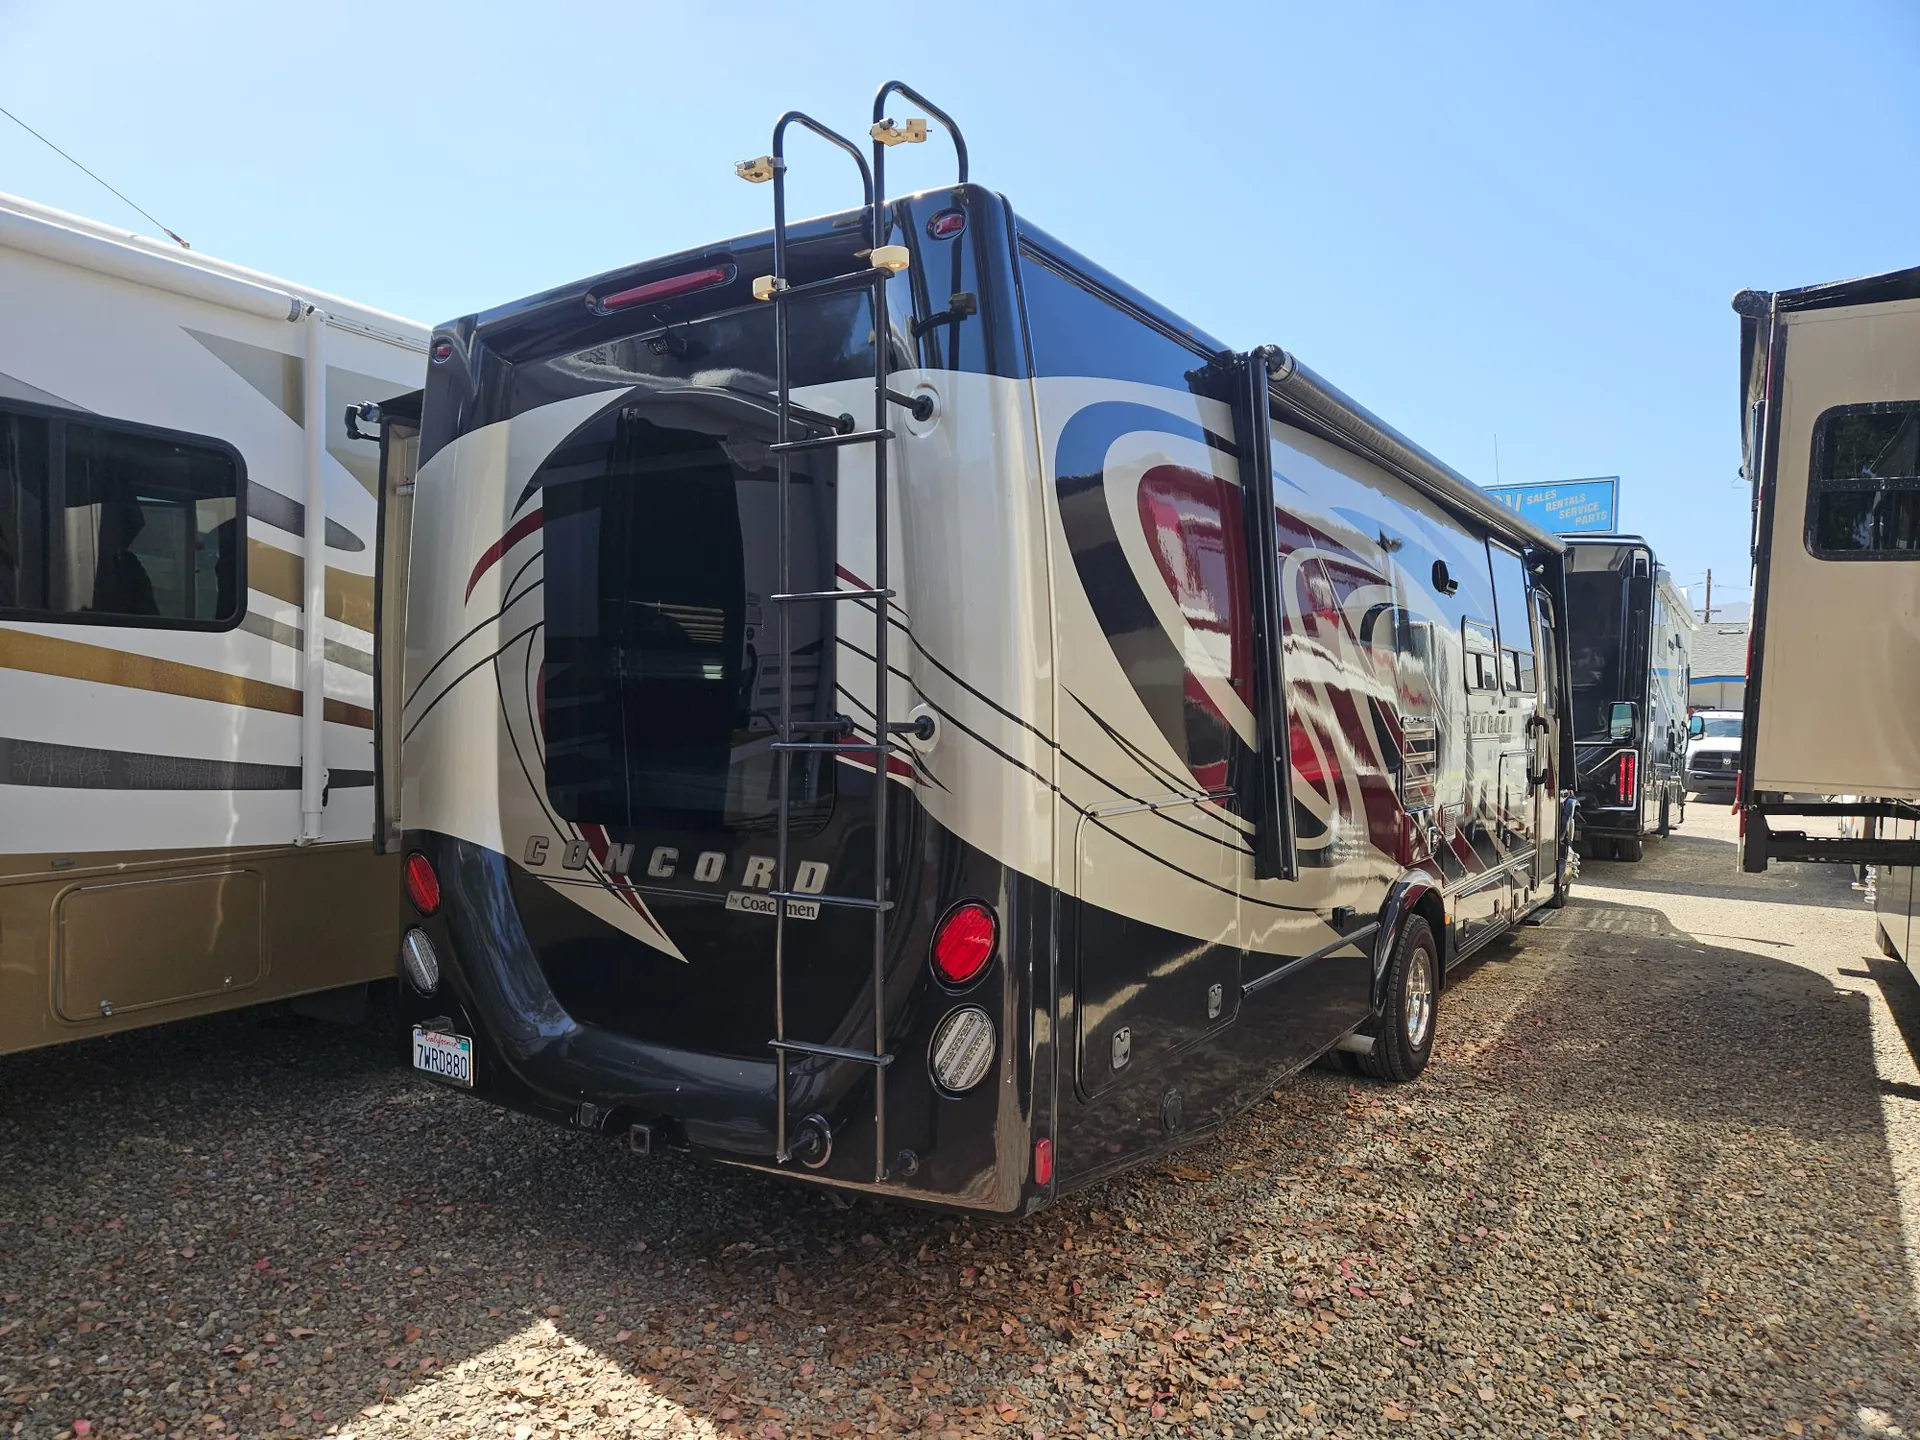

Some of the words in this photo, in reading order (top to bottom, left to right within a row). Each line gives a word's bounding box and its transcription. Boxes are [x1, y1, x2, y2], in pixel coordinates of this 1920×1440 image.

[1494, 493, 1523, 512] V
[1526, 489, 1557, 505] SALES
[1545, 493, 1586, 512] RENTALS
[1559, 501, 1600, 520] SERVICE
[1575, 510, 1608, 527] PARTS
[523, 835, 829, 895] CONCORD
[729, 894, 740, 906] by
[741, 896, 816, 918] Coacmen
[417, 1044, 468, 1080] 7WRD880
